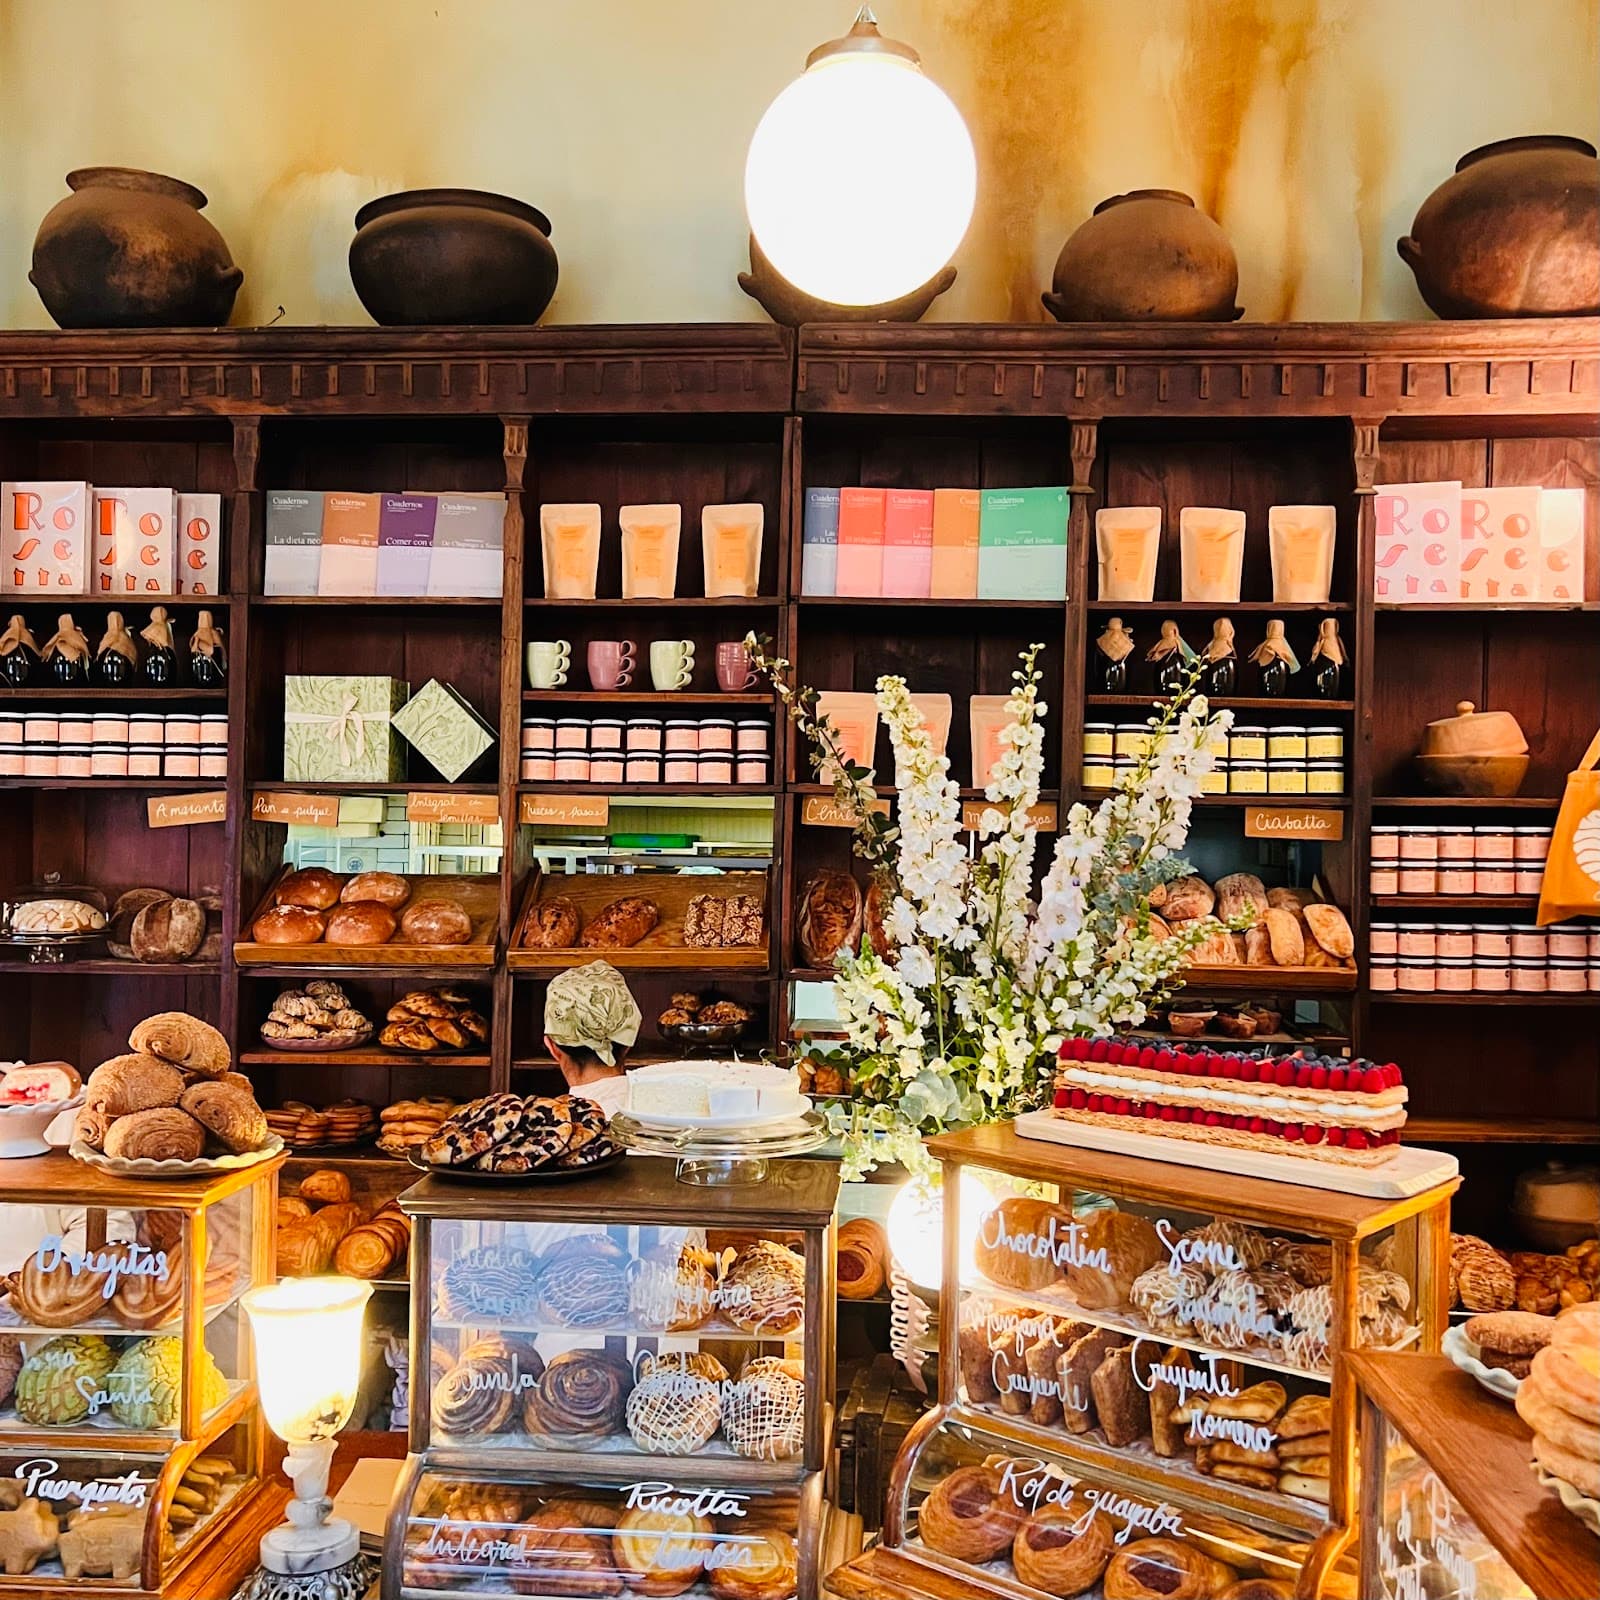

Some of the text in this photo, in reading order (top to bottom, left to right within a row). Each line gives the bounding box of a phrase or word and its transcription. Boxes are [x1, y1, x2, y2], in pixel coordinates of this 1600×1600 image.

[272, 497, 309, 505] Cuadernos
[386, 499, 423, 508] Cuadernos
[987, 496, 1024, 504] Cuadernos
[385, 537, 412, 546] Comer
[1255, 813, 1331, 831] Ciabatta
[1046, 1477, 1075, 1510] de
[619, 1481, 751, 1518] Ricotta
